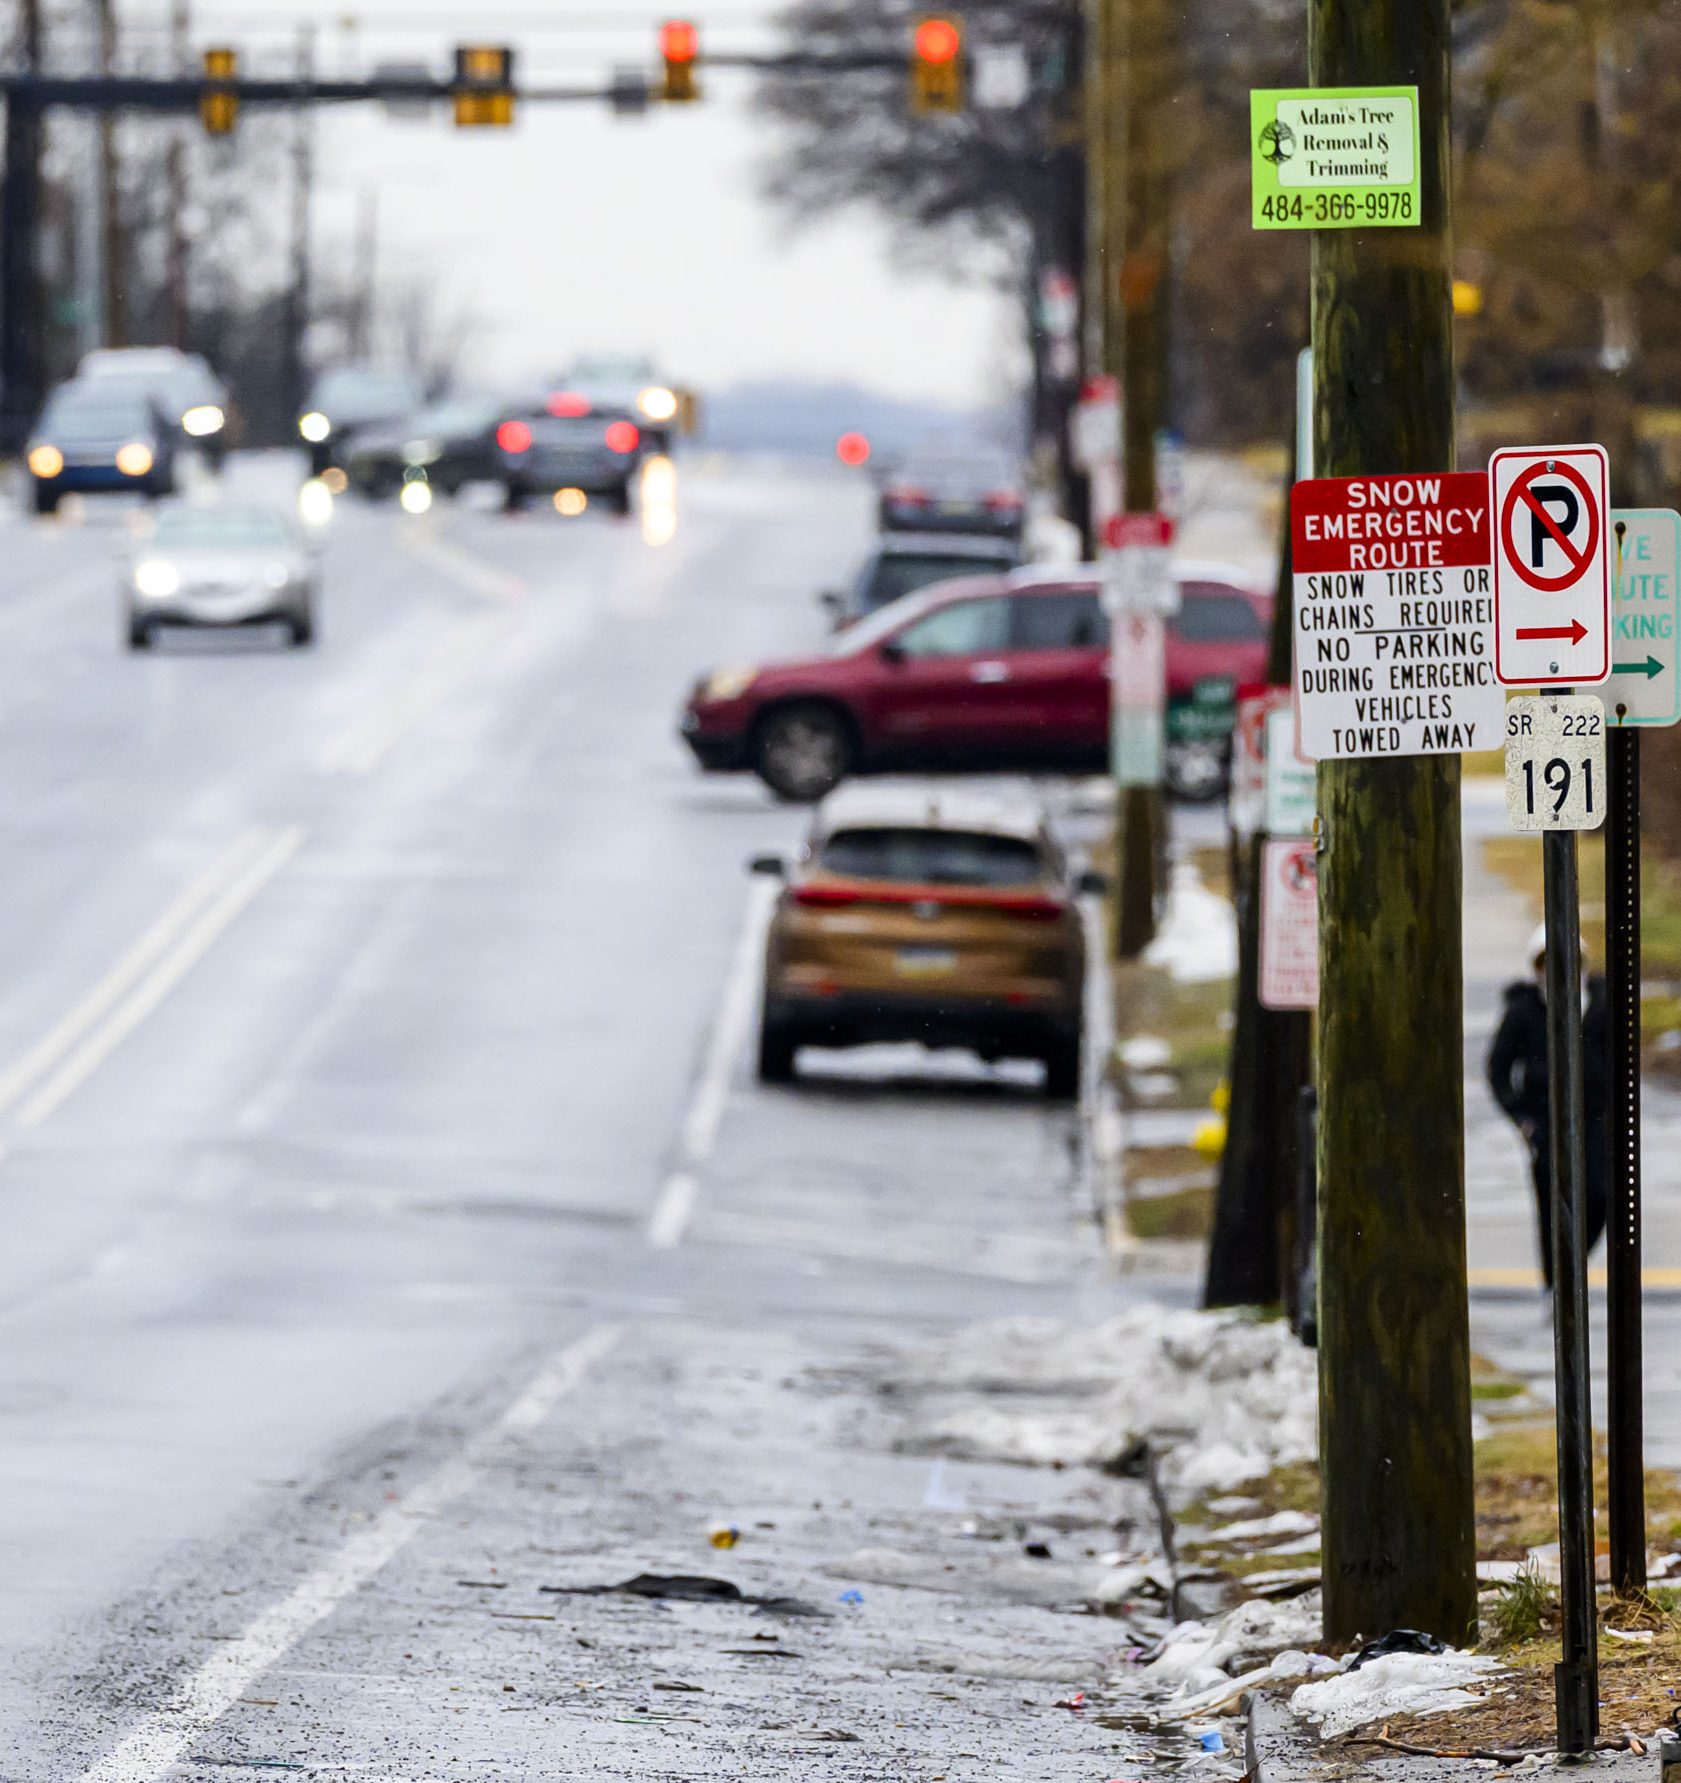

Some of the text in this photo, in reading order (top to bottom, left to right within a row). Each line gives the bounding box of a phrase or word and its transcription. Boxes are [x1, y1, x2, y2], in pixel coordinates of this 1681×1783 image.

[1359, 106, 1395, 124] Tree
[1302, 131, 1390, 154] Removal &
[1306, 159, 1389, 180] Trimming
[1261, 191, 1412, 222] 484-366-9978
[1347, 480, 1441, 507] SNOW
[1305, 508, 1484, 541] EMERGENCY
[1349, 540, 1444, 569] ROUTE
[1619, 535, 1652, 561] VE
[1307, 568, 1489, 600] SNOW TIRES OR
[1612, 574, 1669, 601] UTE
[1299, 605, 1375, 631] CHAINS
[1614, 613, 1673, 640] KING
[1317, 631, 1484, 662] NO PARKING
[1302, 667, 1374, 693] DURING
[1355, 694, 1452, 722] VEHICLES
[1332, 723, 1476, 754] TOWED AWAY
[1507, 714, 1601, 736] SR 222
[1522, 757, 1593, 815] 191
